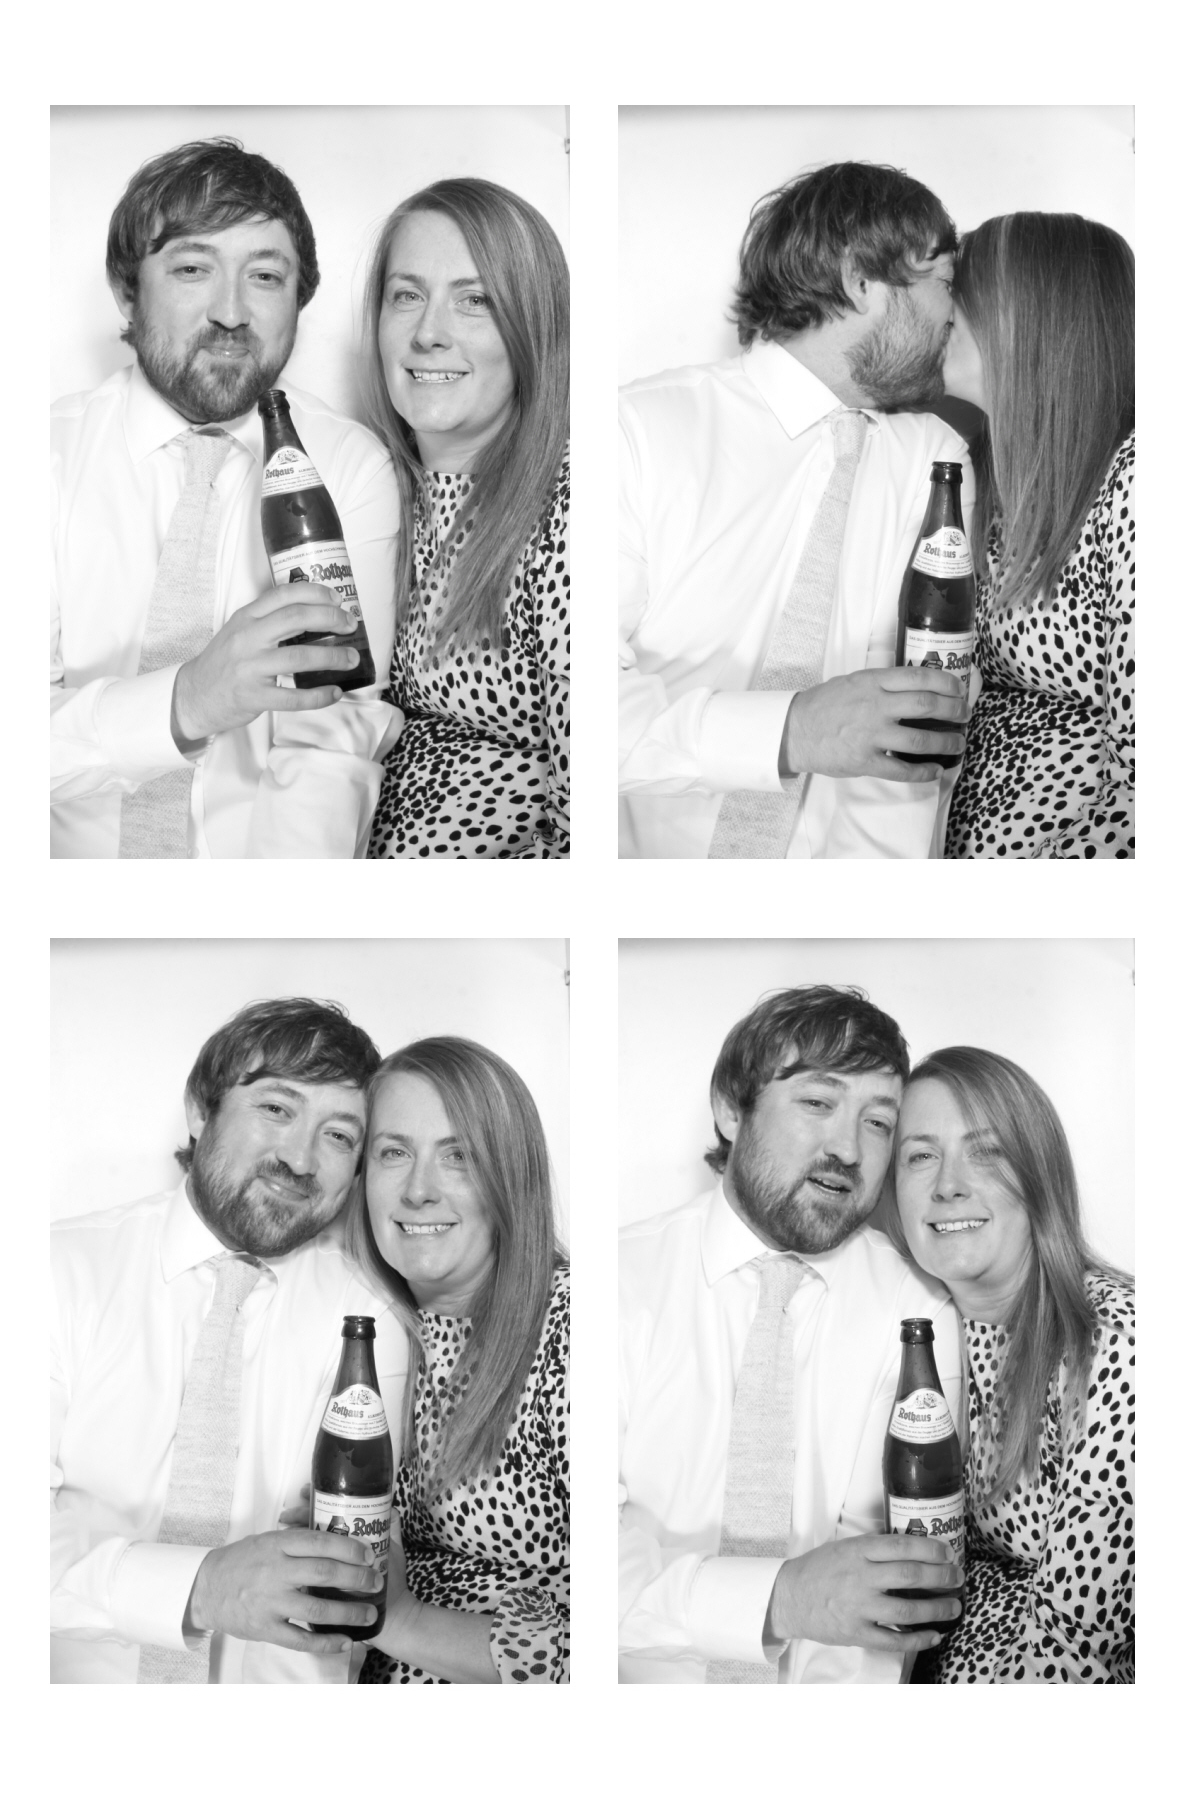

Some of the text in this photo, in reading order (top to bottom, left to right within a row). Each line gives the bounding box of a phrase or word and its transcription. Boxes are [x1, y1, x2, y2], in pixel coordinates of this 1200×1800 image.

[265, 467, 295, 480] Rothaus
[310, 562, 353, 582] Rothau
[331, 1401, 364, 1419] Rothaus
[898, 1407, 931, 1423] Rothaus
